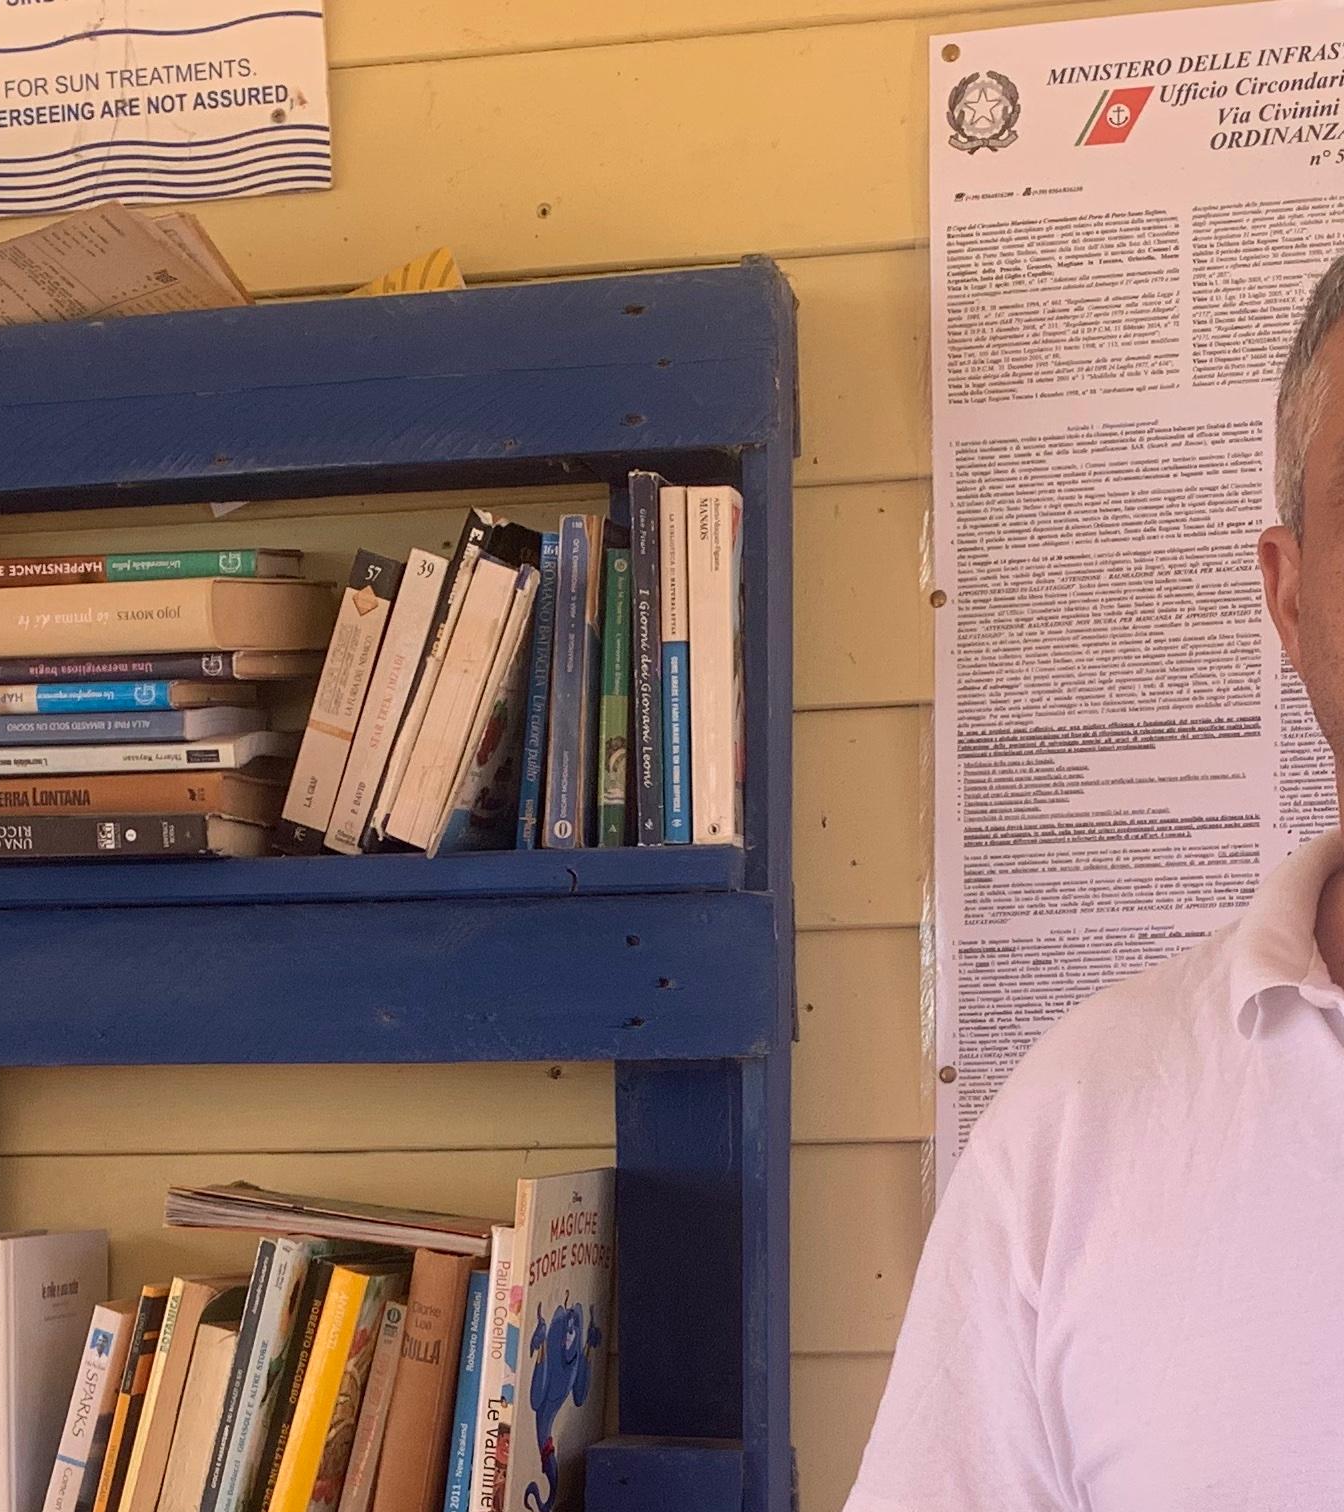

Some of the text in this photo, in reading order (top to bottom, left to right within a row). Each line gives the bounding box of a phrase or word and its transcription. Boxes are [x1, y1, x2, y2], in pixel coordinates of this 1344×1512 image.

[6, 78, 49, 97] FOR
[55, 72, 100, 94] SUN
[106, 58, 257, 89] TREATMENTS.
[1046, 58, 1172, 86] MINISTERO
[1177, 51, 1252, 73] DELLE
[100, 98, 140, 119] ARE
[146, 93, 189, 114] NOT
[1159, 83, 1227, 106] Ufficio
[1217, 107, 1250, 125] Via
[1258, 102, 1339, 124] Civinini
[1309, 151, 1331, 166] n°
[699, 498, 709, 541] MANAOS
[8, 561, 102, 577] HAPPENSTANCE
[365, 565, 382, 581] 57
[417, 560, 435, 578] 39
[117, 606, 181, 621] JOJO MOYES
[32, 785, 90, 807] LONTANA
[3, 835, 32, 850] UNA
[550, 1212, 598, 1242] MAGICHE
[528, 1255, 567, 1286] STORIE
[73, 1368, 102, 1438] SPARKS
[447, 1483, 464, 1509] 2011
